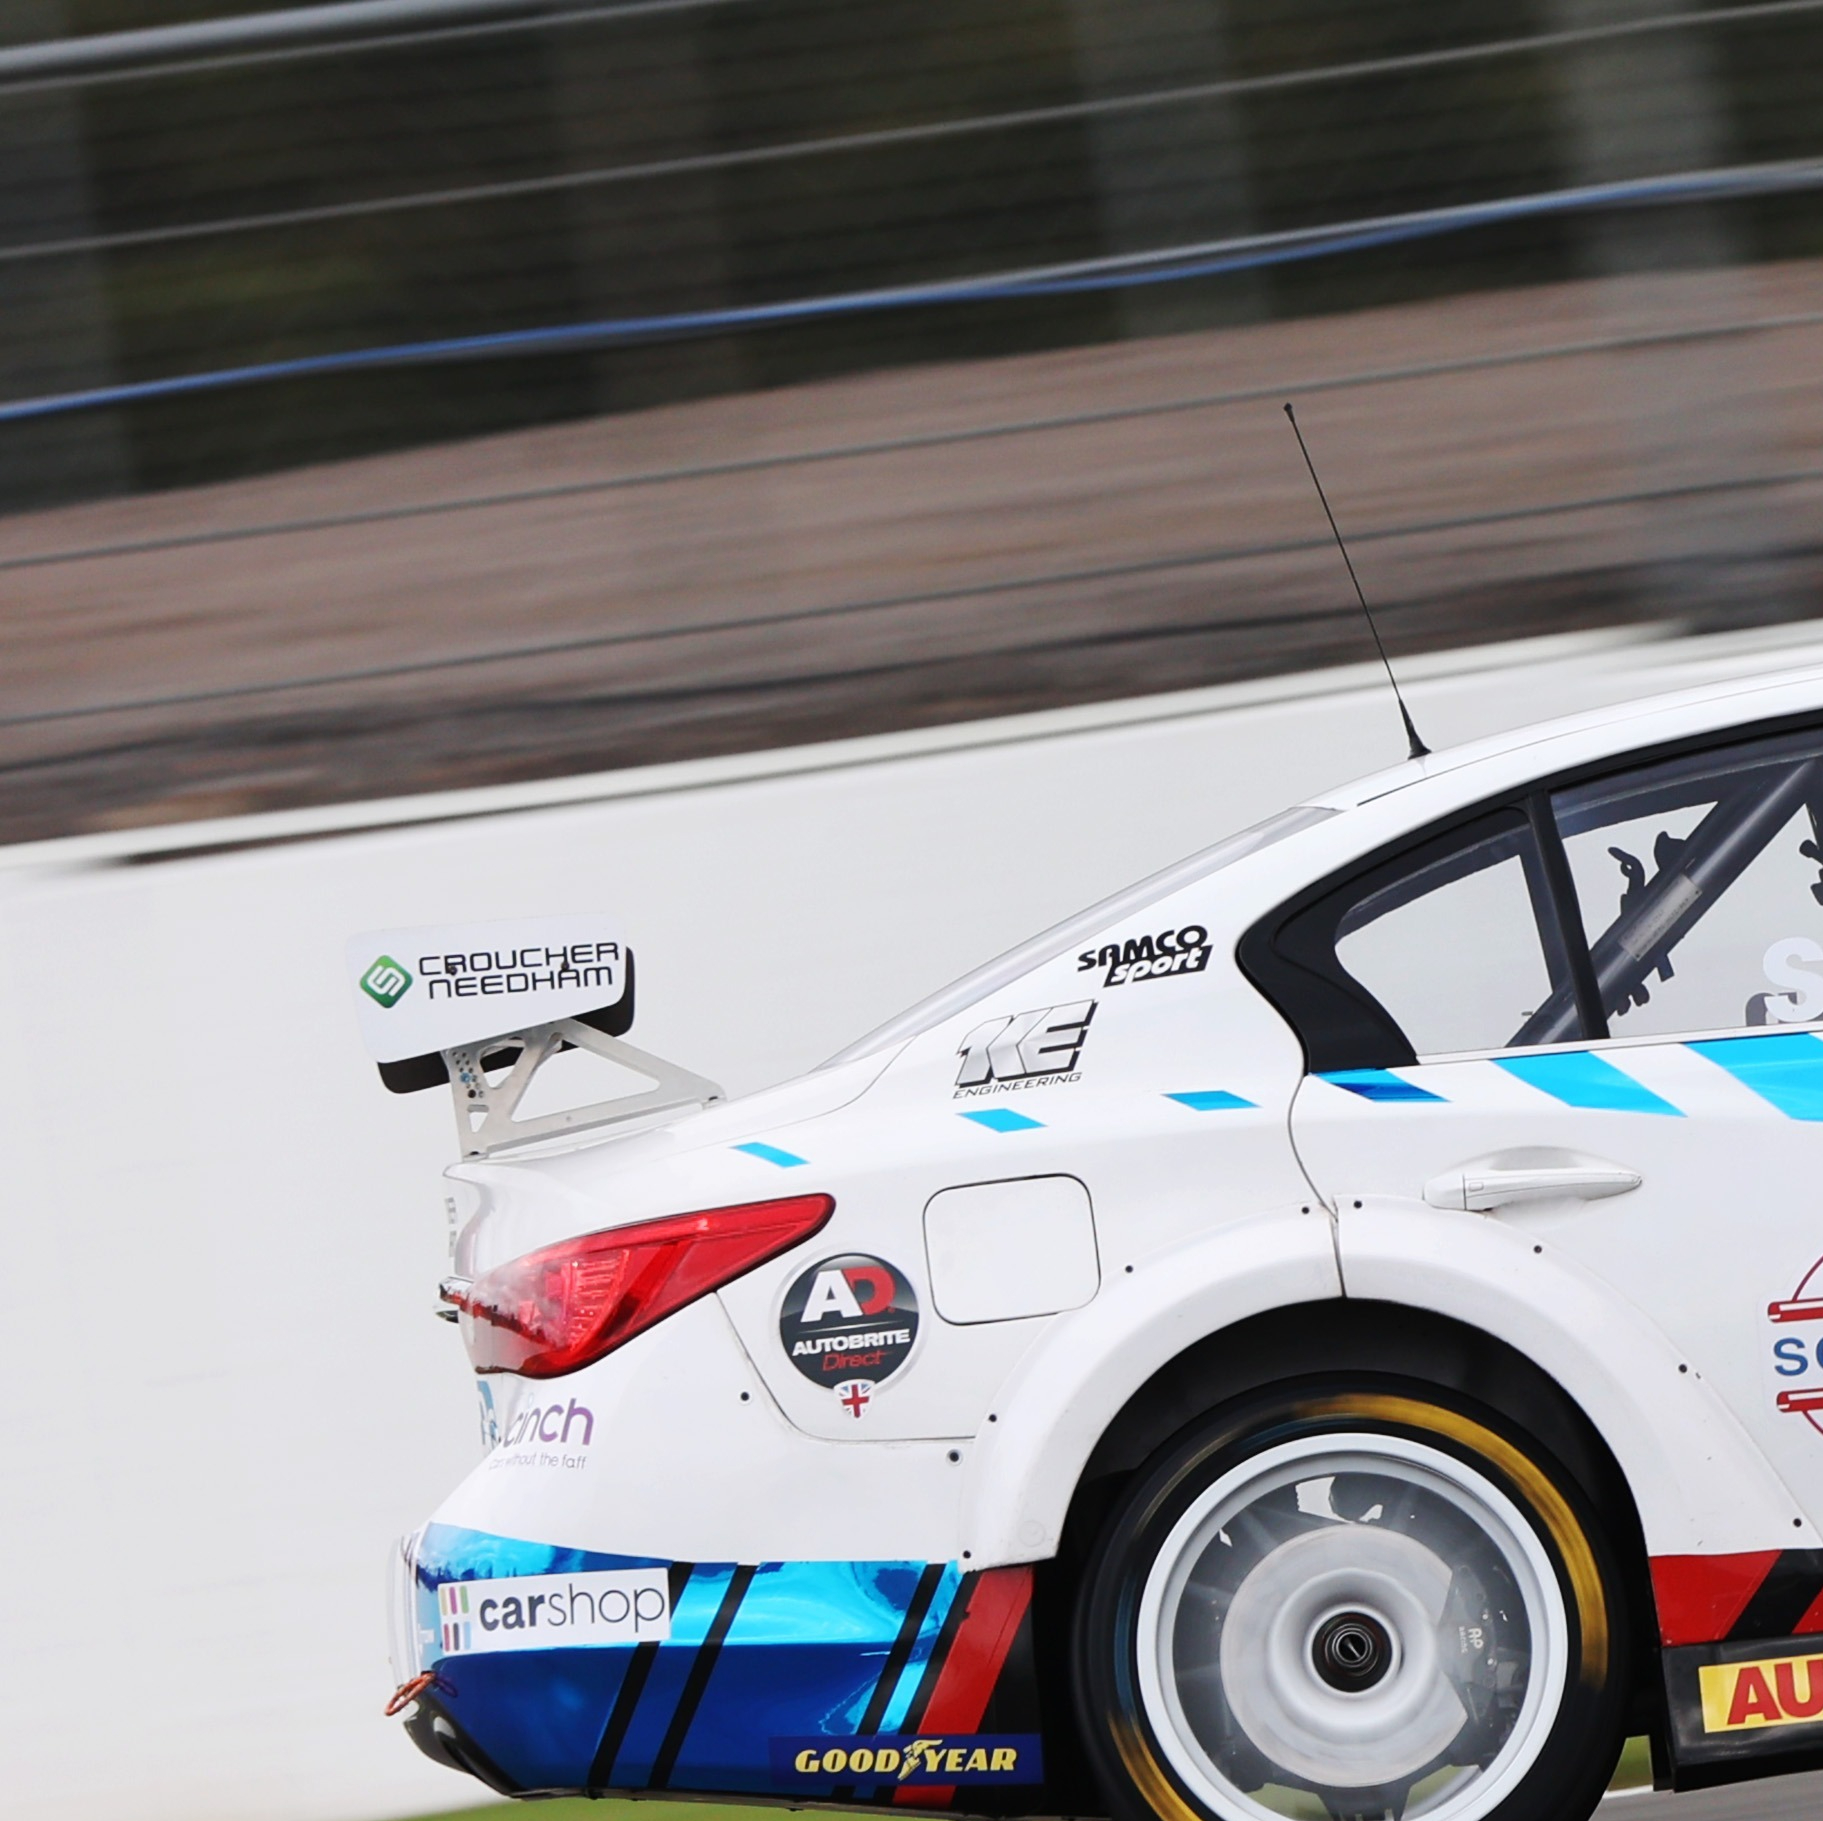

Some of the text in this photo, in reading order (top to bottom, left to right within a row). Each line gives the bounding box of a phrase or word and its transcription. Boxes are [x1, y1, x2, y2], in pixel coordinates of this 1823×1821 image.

[419, 942, 620, 976] CROUCHER
[1077, 925, 1208, 972] SAMCO
[1110, 947, 1204, 984] sport
[429, 966, 614, 999] NEEDHAM
[952, 1072, 1084, 1099] ENGINEERING
[801, 1265, 896, 1323] AD
[791, 1328, 911, 1356] AUTOBRITE
[822, 1350, 889, 1372] Direct
[503, 1397, 594, 1448] cinch
[479, 1583, 666, 1633] carshop
